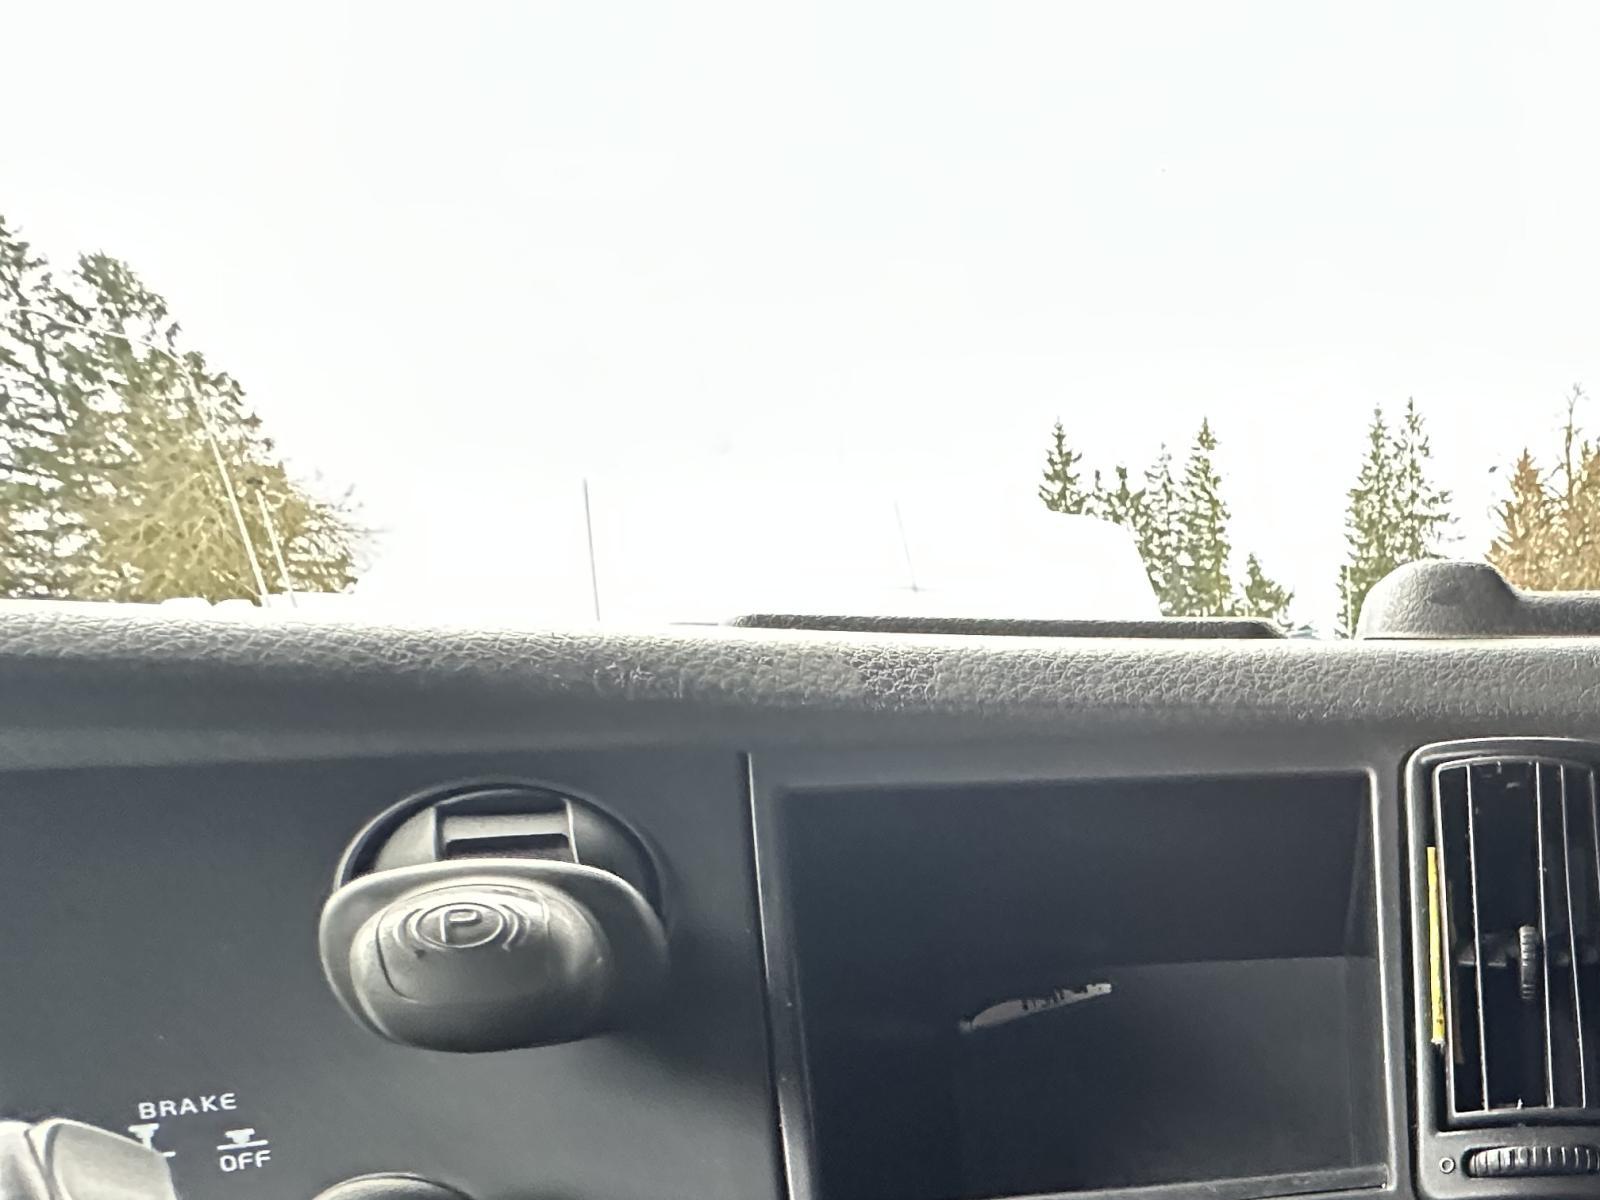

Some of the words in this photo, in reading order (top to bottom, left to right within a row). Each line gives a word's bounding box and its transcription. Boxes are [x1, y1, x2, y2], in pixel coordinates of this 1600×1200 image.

[439, 908, 480, 945] P
[138, 1092, 237, 1119] BRAKE
[220, 1150, 271, 1172] OFF
